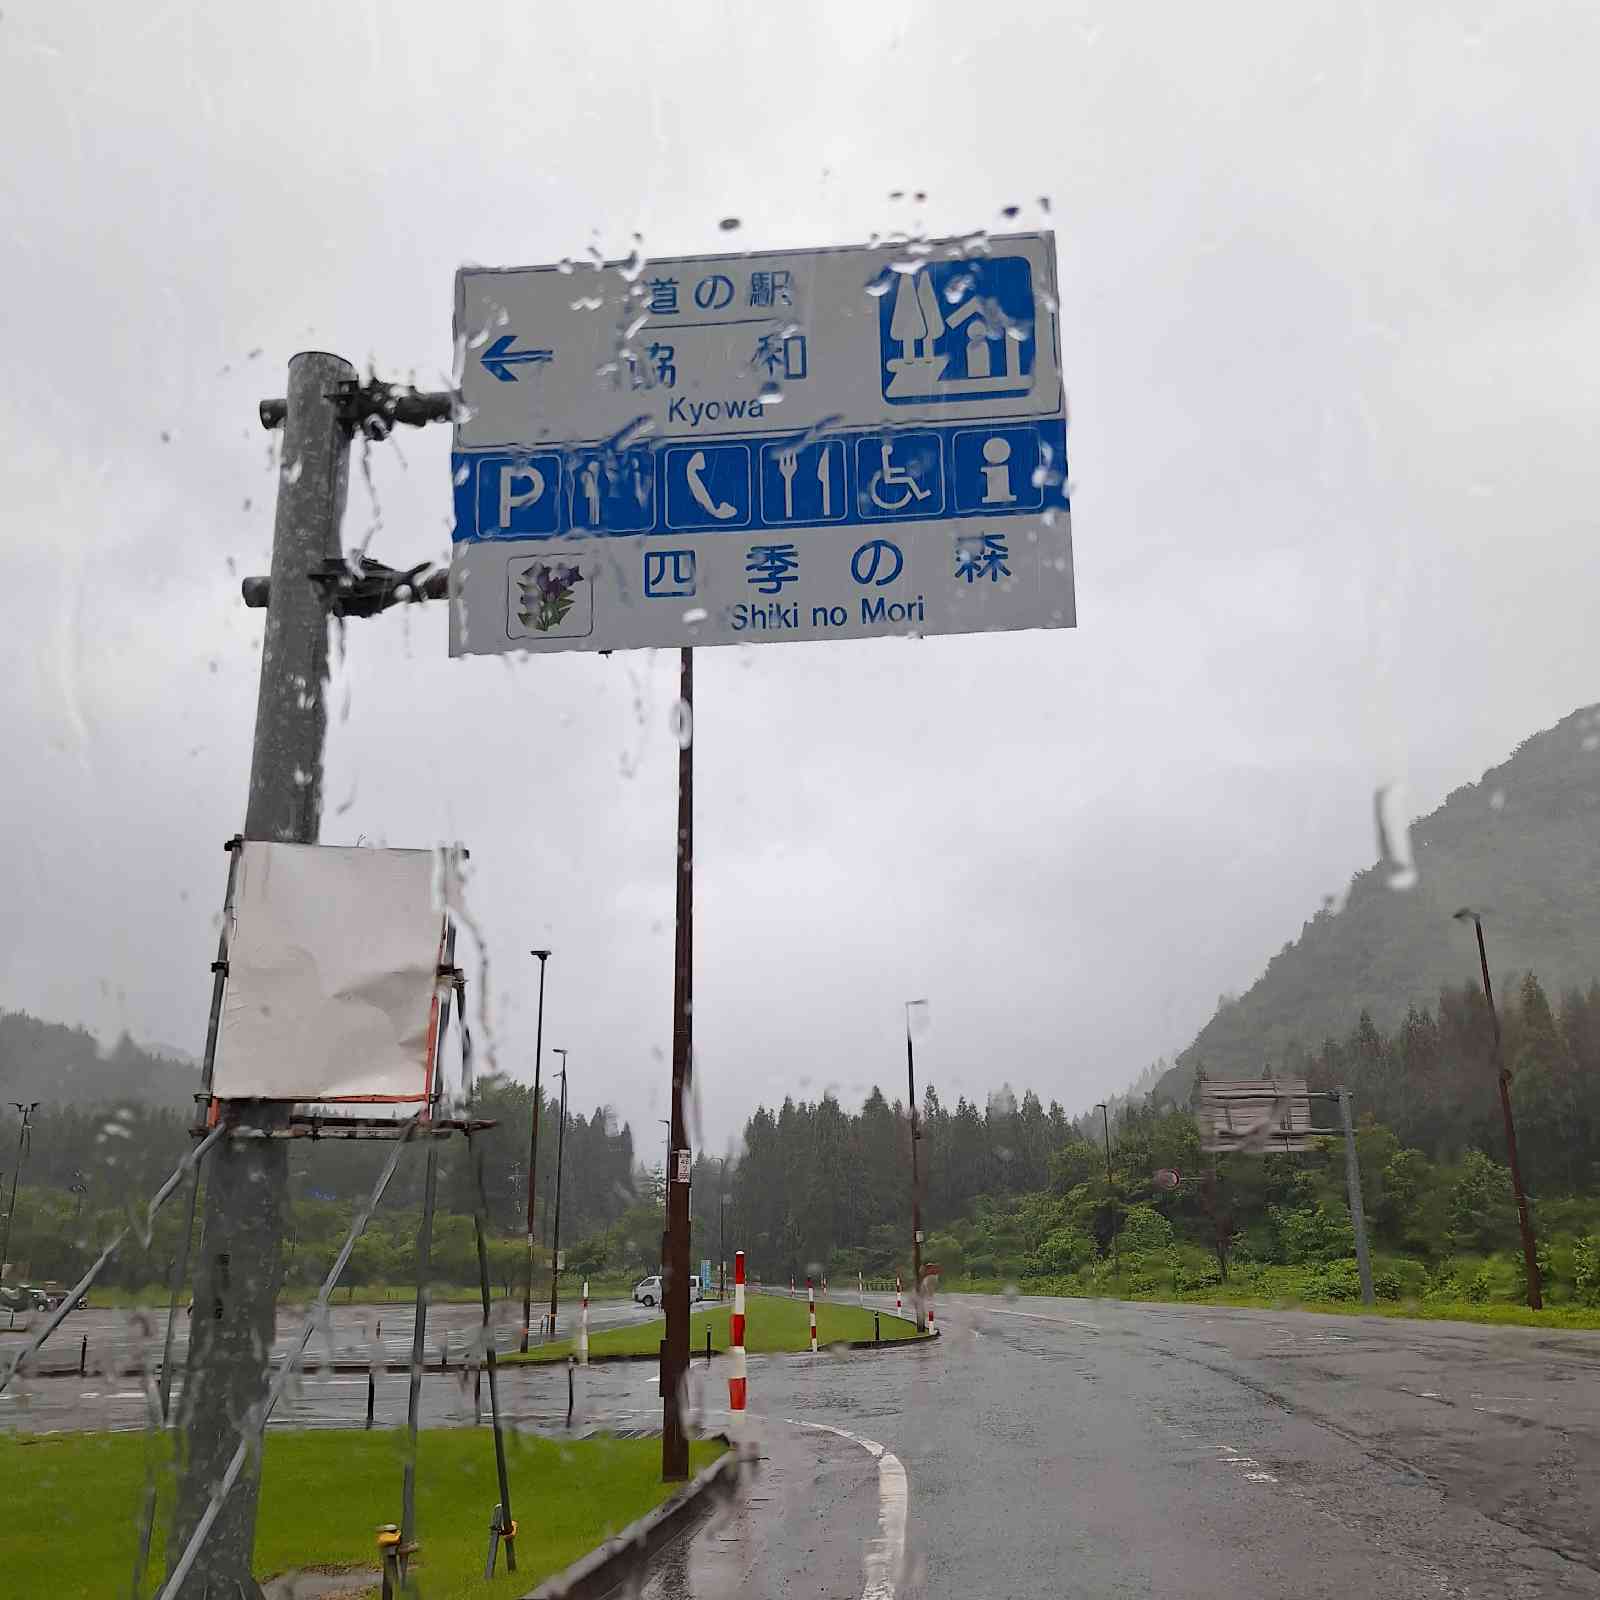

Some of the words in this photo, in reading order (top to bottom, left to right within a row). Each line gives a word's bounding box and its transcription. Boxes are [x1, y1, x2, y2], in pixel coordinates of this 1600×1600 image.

[645, 271, 793, 314] 道の駅
[668, 396, 764, 426] Kyowa
[499, 465, 545, 528] P
[644, 533, 1012, 597] 四季の森
[731, 602, 799, 631] Shiki
[812, 605, 848, 627] no
[861, 595, 925, 625] Mori
